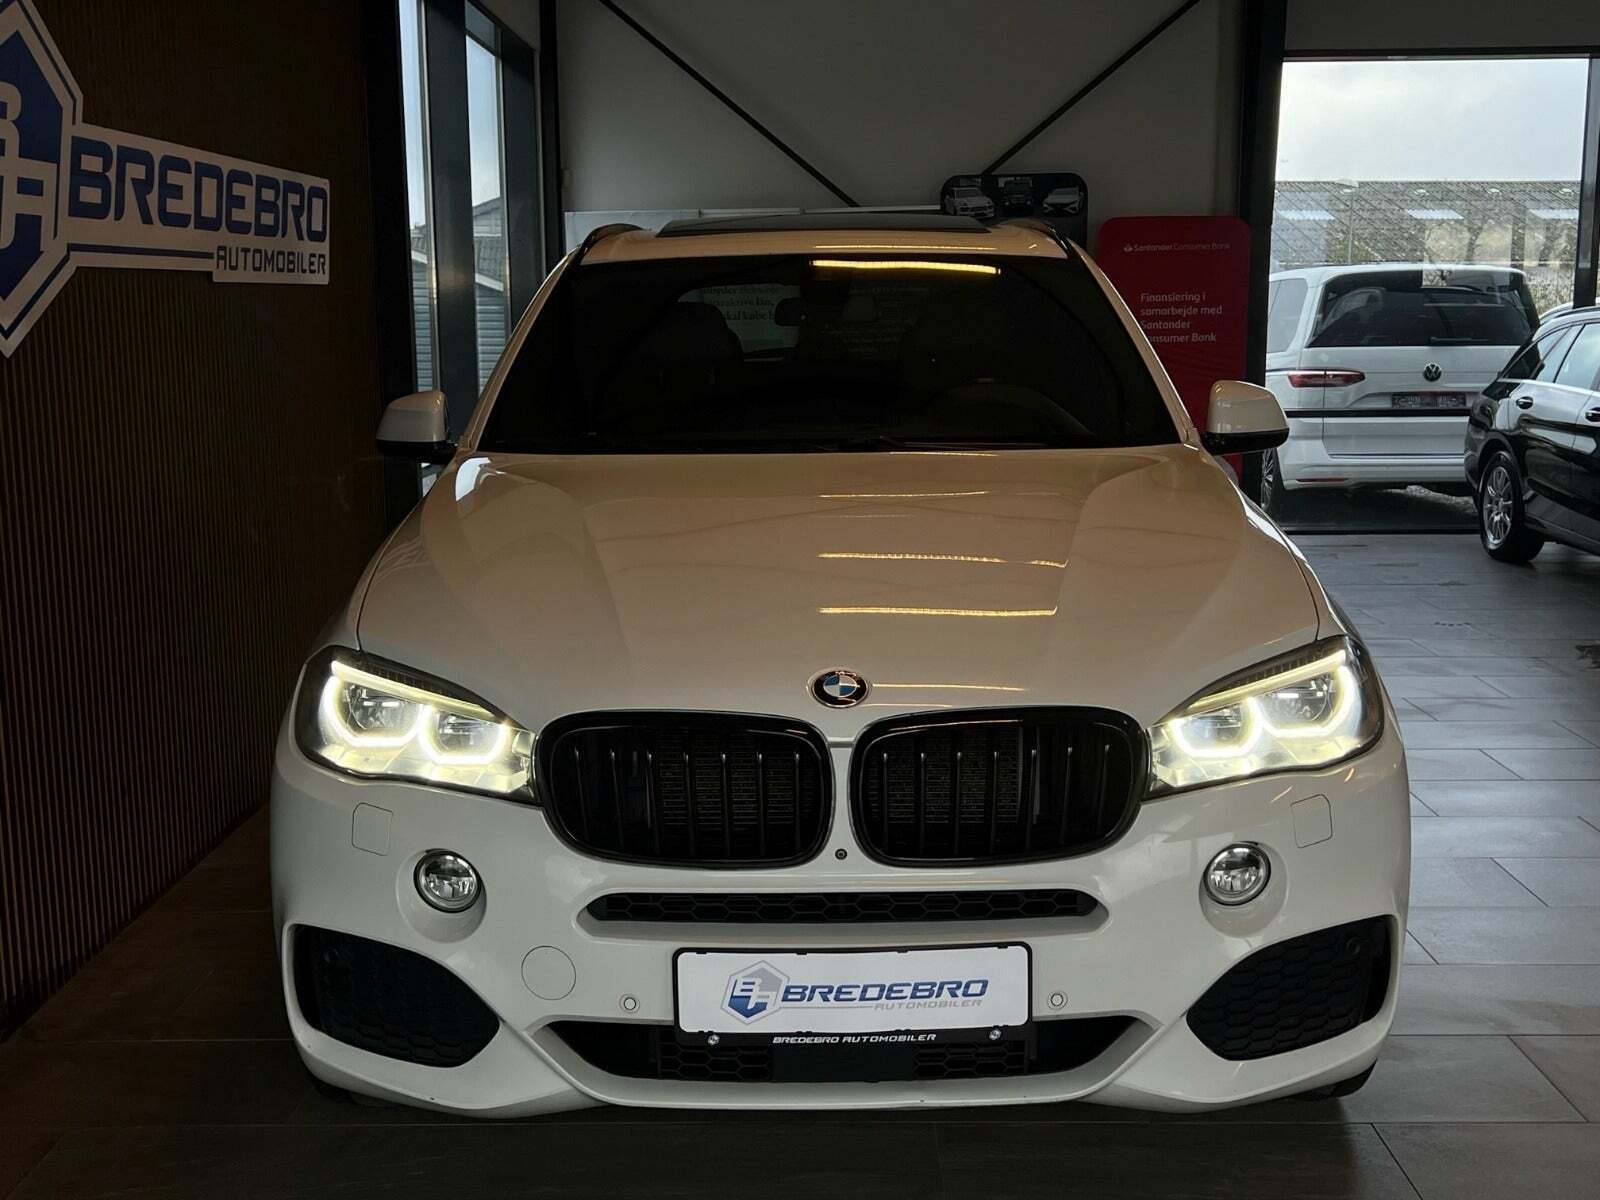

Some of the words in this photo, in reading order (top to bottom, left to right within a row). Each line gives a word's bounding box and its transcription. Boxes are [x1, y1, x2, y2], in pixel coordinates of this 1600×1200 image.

[68, 135, 328, 243] BREDEBRO
[216, 245, 327, 275] AUTOMOBILER
[1140, 292, 1200, 304] Finansiering
[1140, 306, 1199, 317] samarbejde
[1200, 305, 1223, 315] med
[1147, 333, 1190, 343] onsumer
[1191, 332, 1217, 342] Bank
[781, 978, 989, 1003] BREDEBRO
[873, 999, 983, 1011] AUTOMOBILER
[772, 1036, 840, 1044] BREDEBRO
[841, 1033, 937, 1043] AUTOMOBILER
